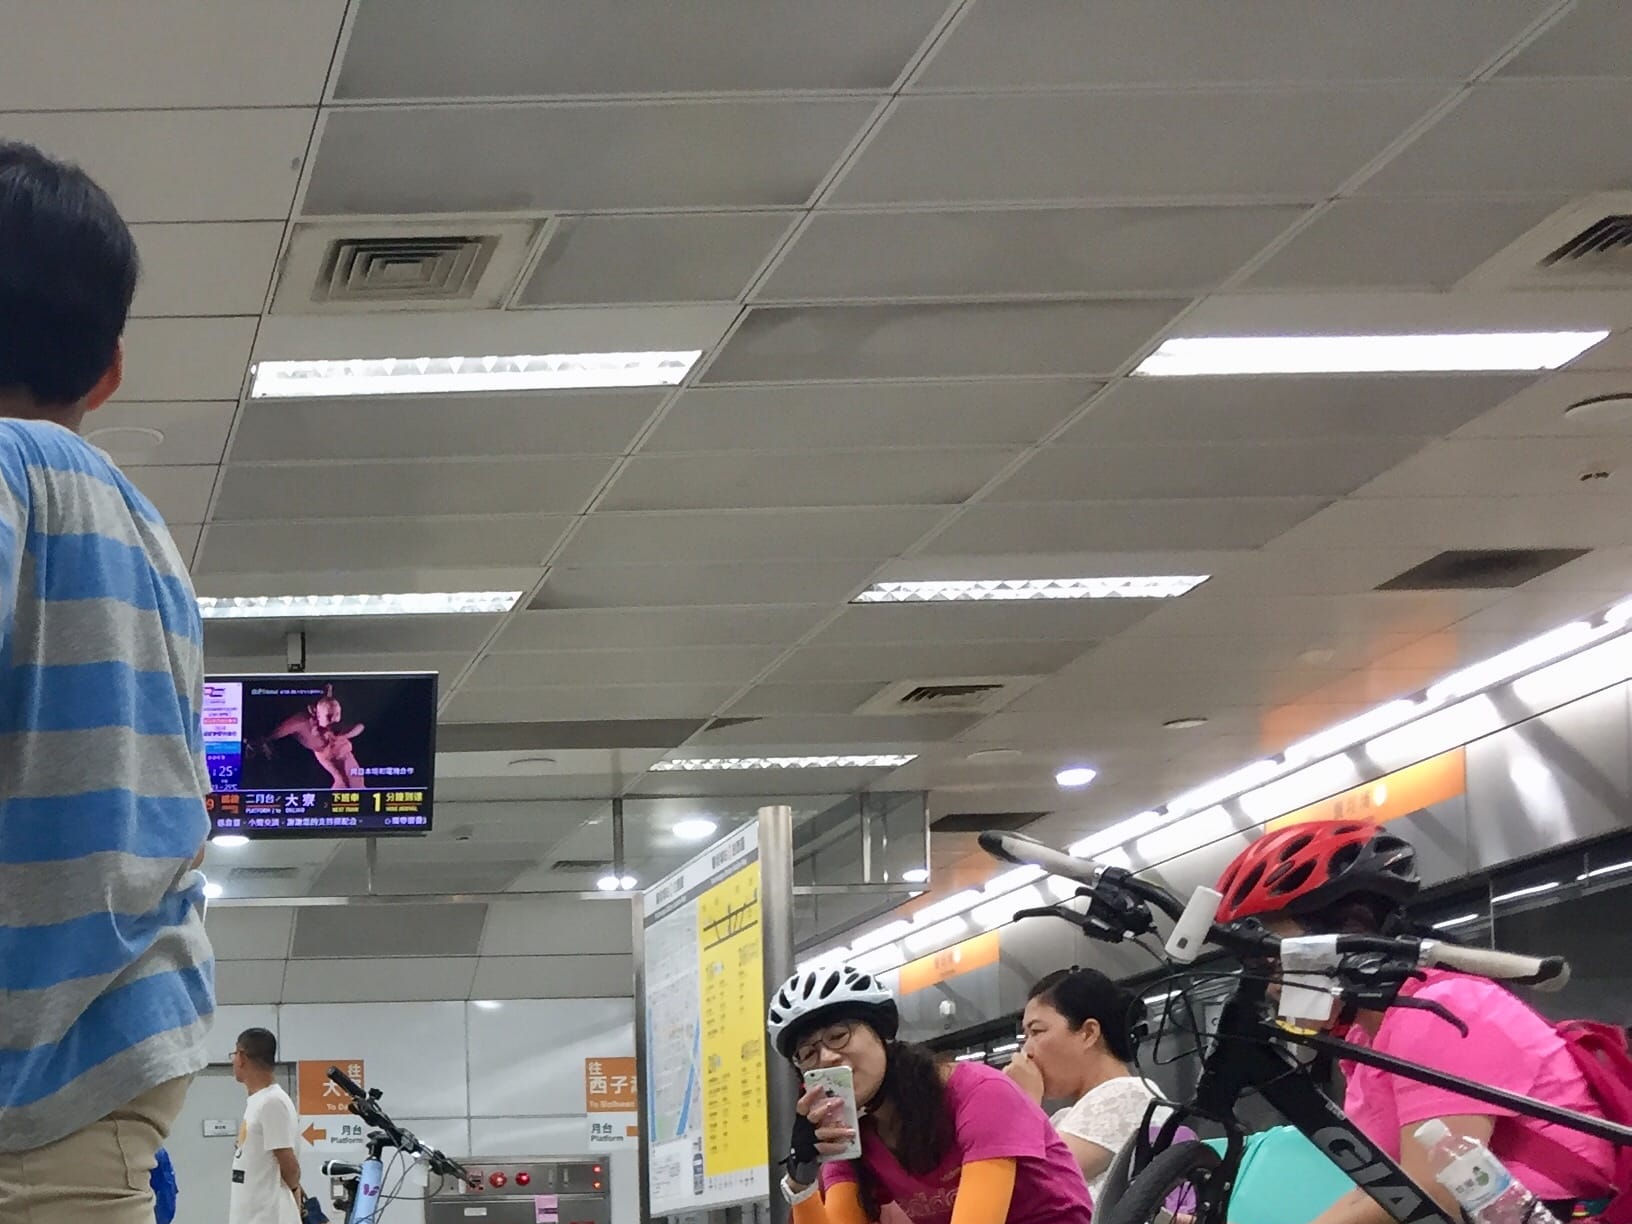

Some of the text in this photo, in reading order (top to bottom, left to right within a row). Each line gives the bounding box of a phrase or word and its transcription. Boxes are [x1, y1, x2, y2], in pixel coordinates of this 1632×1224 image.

[372, 792, 381, 812] 1
[588, 1061, 603, 1076] 往
[340, 1125, 363, 1137] 月台
[591, 1123, 613, 1135] 月台
